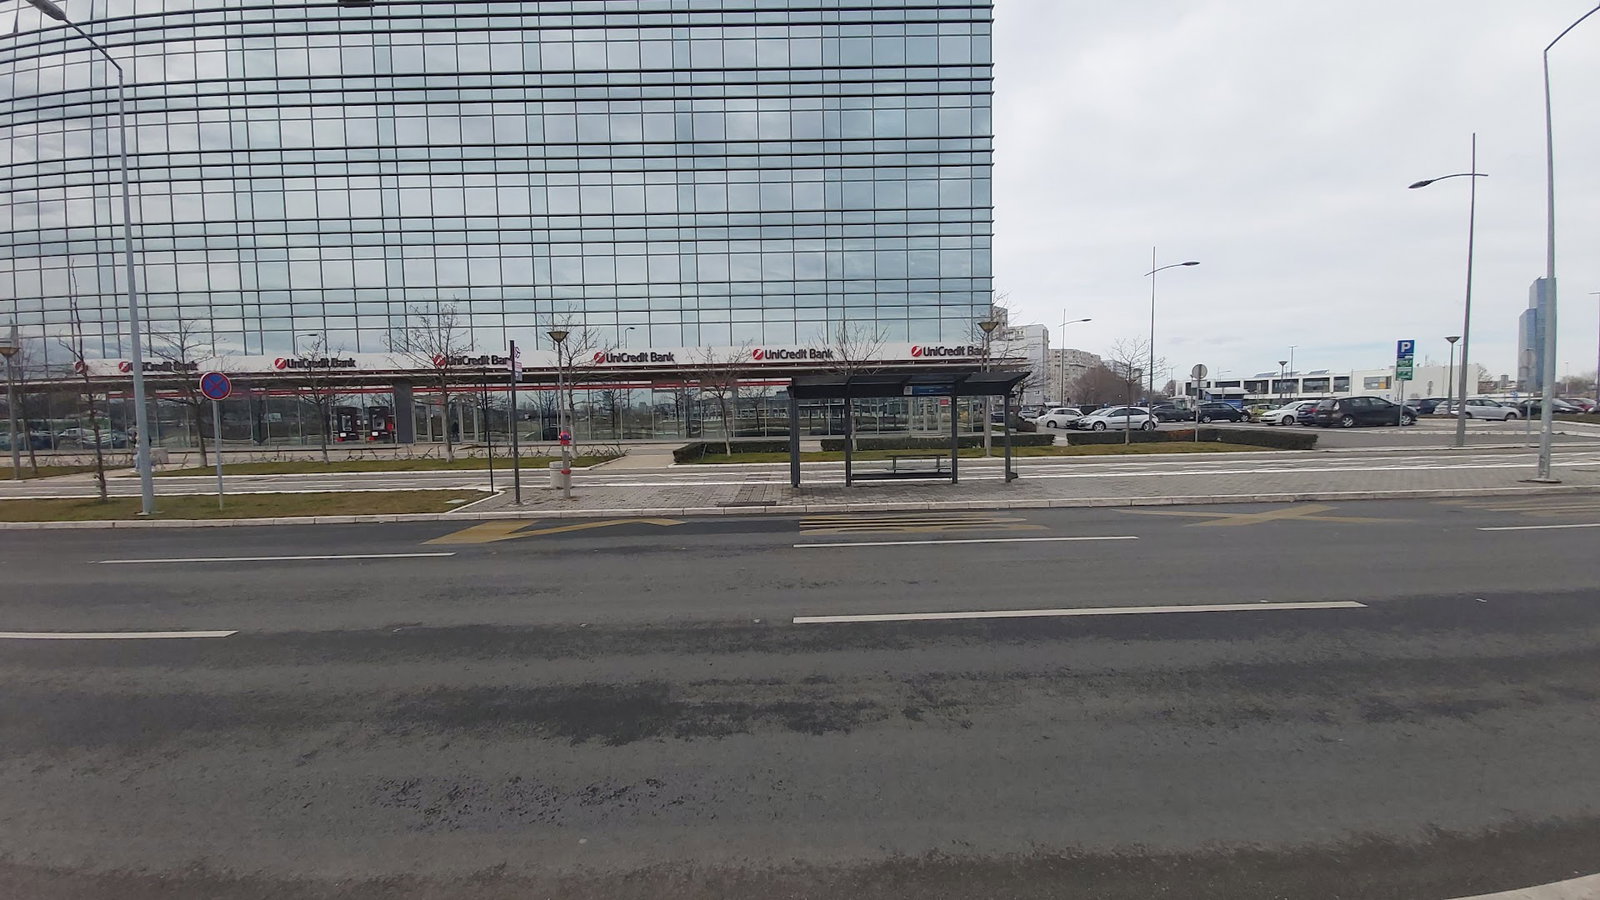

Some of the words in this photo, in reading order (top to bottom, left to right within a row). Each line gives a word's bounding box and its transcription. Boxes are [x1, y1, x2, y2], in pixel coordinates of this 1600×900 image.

[923, 346, 966, 357] UniCredit
[1400, 341, 1411, 353] P
[491, 354, 512, 366] Ban
[606, 352, 649, 364] UniCredit
[650, 351, 675, 363] Bank
[764, 349, 808, 360] UniCredit
[809, 348, 834, 359] Bank
[286, 358, 329, 369] UniCredit
[330, 357, 356, 369] Bank
